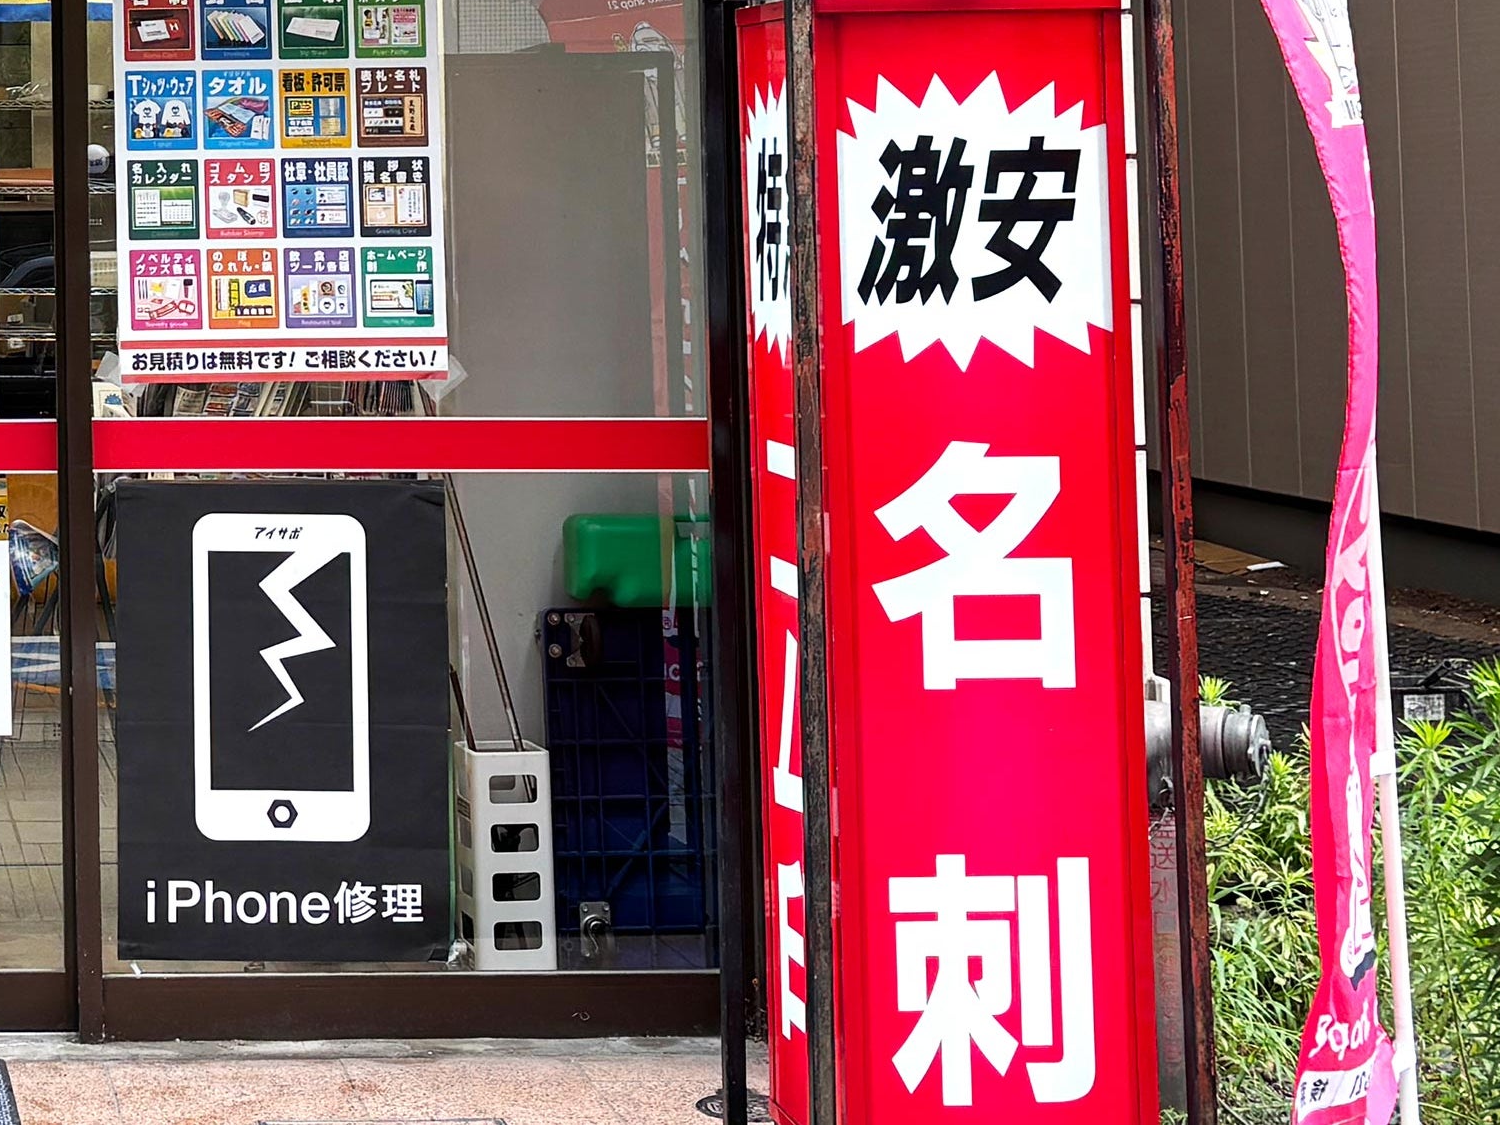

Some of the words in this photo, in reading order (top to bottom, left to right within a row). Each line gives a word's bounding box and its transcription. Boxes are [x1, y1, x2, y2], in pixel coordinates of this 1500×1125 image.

[209, 77, 267, 95] タオル
[756, 136, 791, 304] 特
[856, 134, 1082, 306] 激安
[304, 349, 437, 369] ご相談ください!
[254, 526, 303, 539] アイサポ
[872, 439, 1097, 1108] 名刺
[146, 879, 424, 925] iPhone修理
